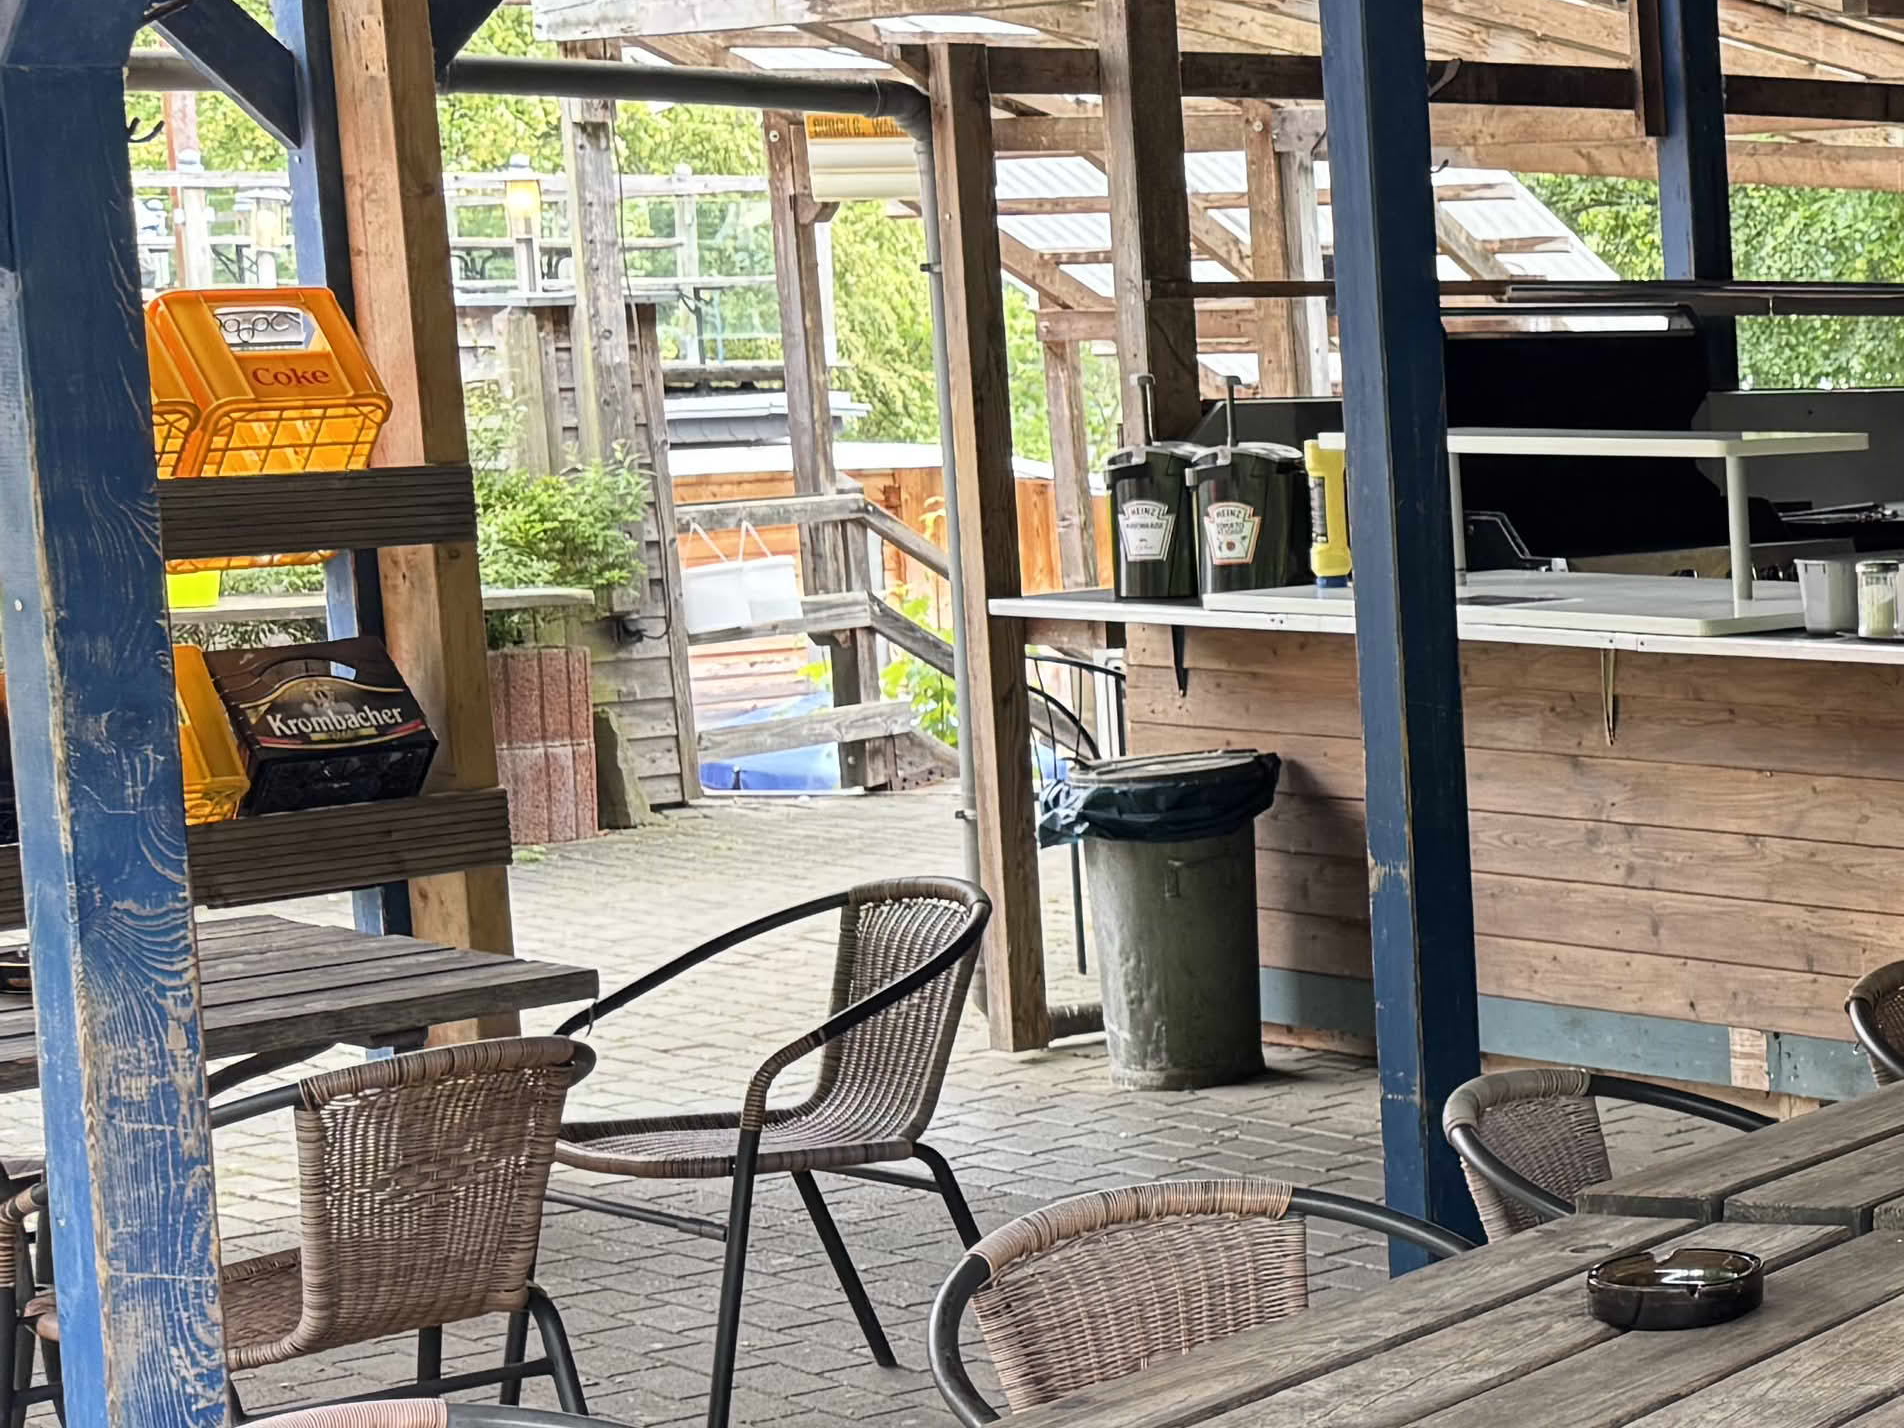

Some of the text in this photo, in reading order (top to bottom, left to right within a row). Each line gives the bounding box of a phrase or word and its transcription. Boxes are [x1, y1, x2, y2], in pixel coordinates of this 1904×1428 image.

[252, 368, 330, 387] Coke
[1130, 507, 1156, 517] HEINZ
[1215, 508, 1242, 519] HEINZ
[266, 705, 403, 737] Krombacher
